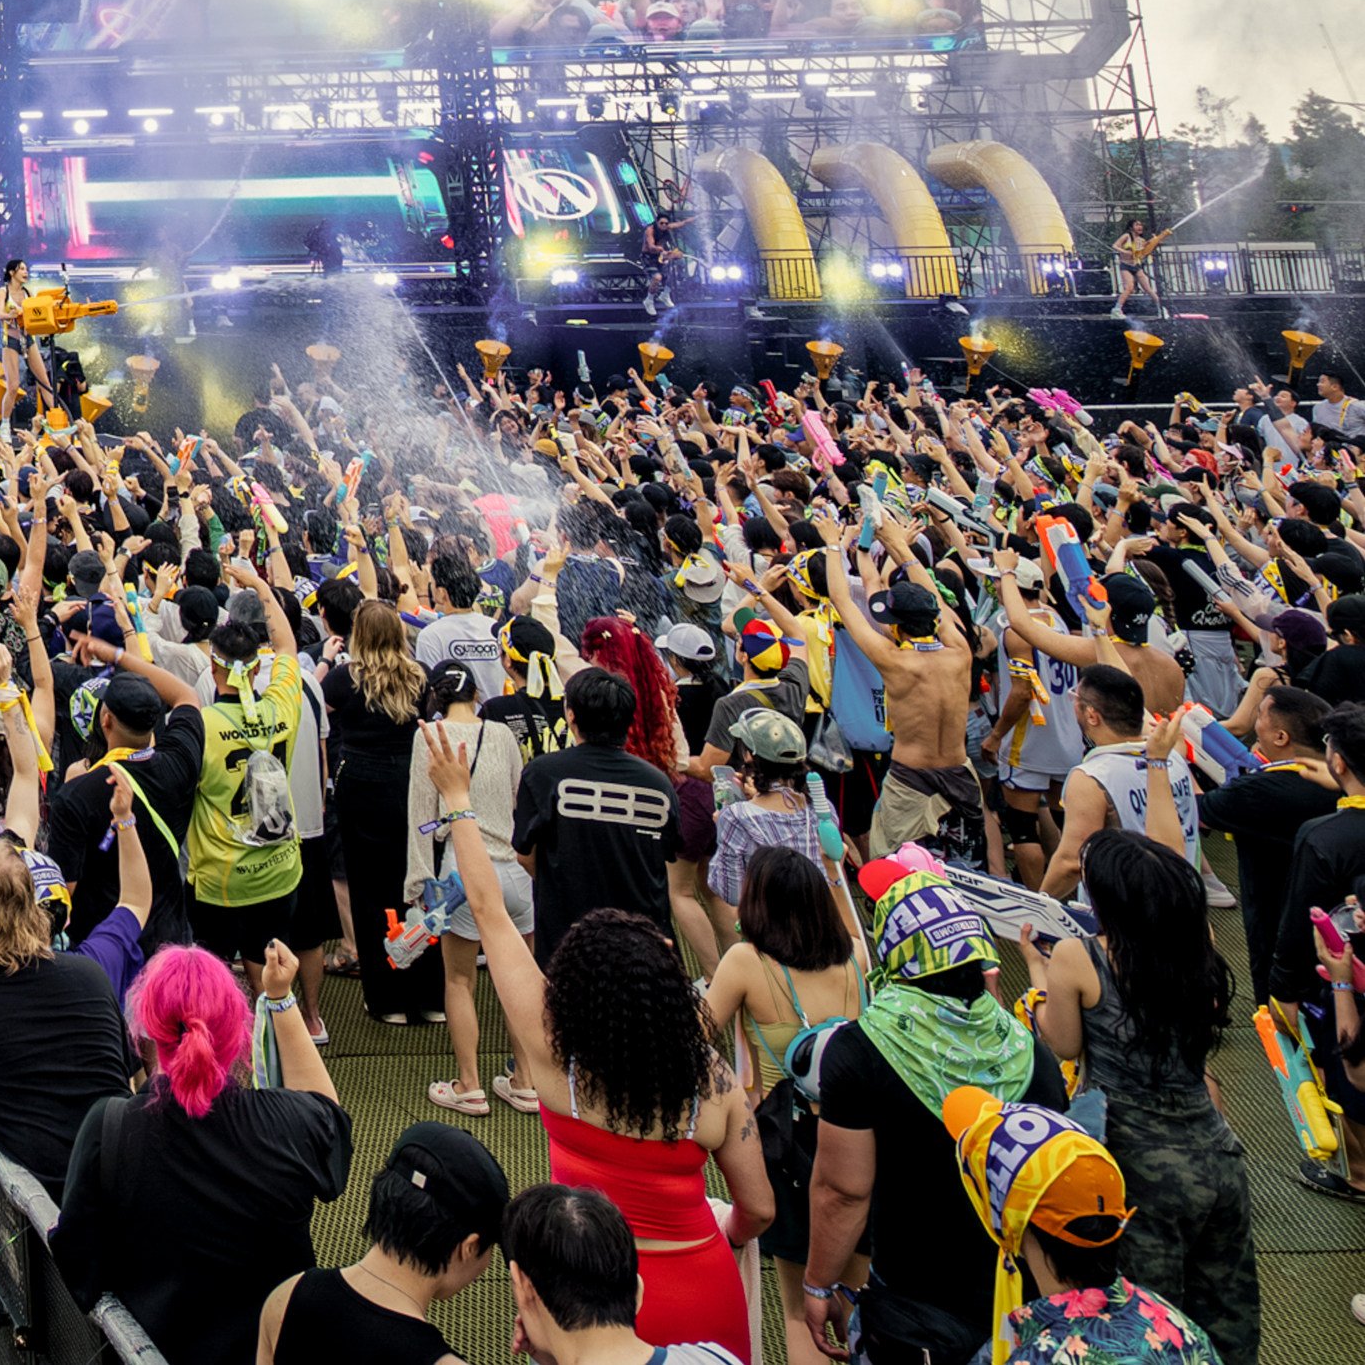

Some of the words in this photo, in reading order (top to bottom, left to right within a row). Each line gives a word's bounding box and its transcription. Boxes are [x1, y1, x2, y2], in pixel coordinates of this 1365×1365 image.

[454, 641, 497, 657] OUTDOOR
[1047, 657, 1078, 695] 30
[219, 728, 259, 741] WORLD
[261, 722, 288, 737] TOUR
